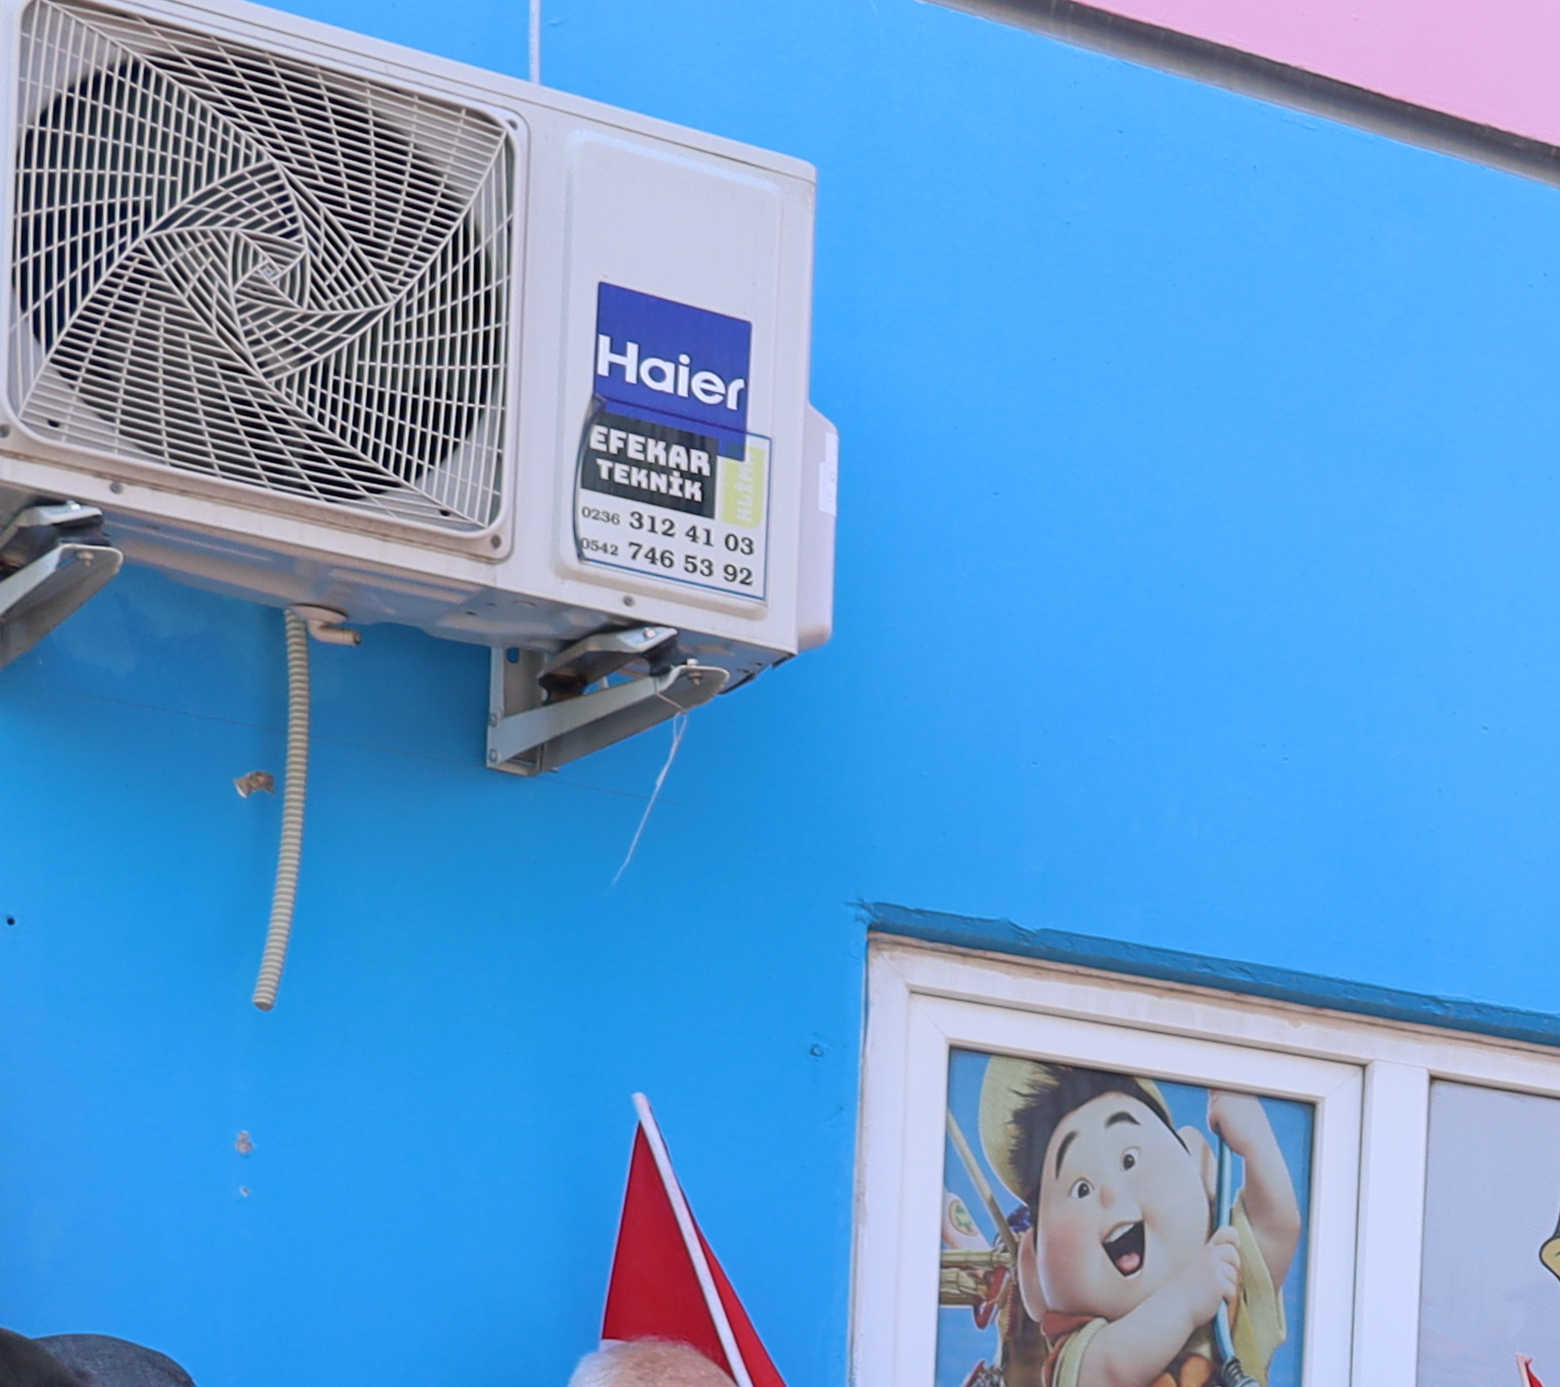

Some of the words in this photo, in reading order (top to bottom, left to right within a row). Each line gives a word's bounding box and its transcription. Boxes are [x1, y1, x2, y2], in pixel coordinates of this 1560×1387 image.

[597, 334, 746, 411] Haier
[590, 424, 711, 477] EFEKAR
[595, 458, 702, 503] TEKNİK
[581, 506, 621, 526] 0236
[629, 511, 676, 538] 312
[685, 525, 714, 548] 41
[724, 533, 755, 556] 03
[581, 538, 619, 557] 0542
[628, 542, 675, 569] 746
[683, 554, 714, 578] 53
[723, 564, 754, 587] 92
